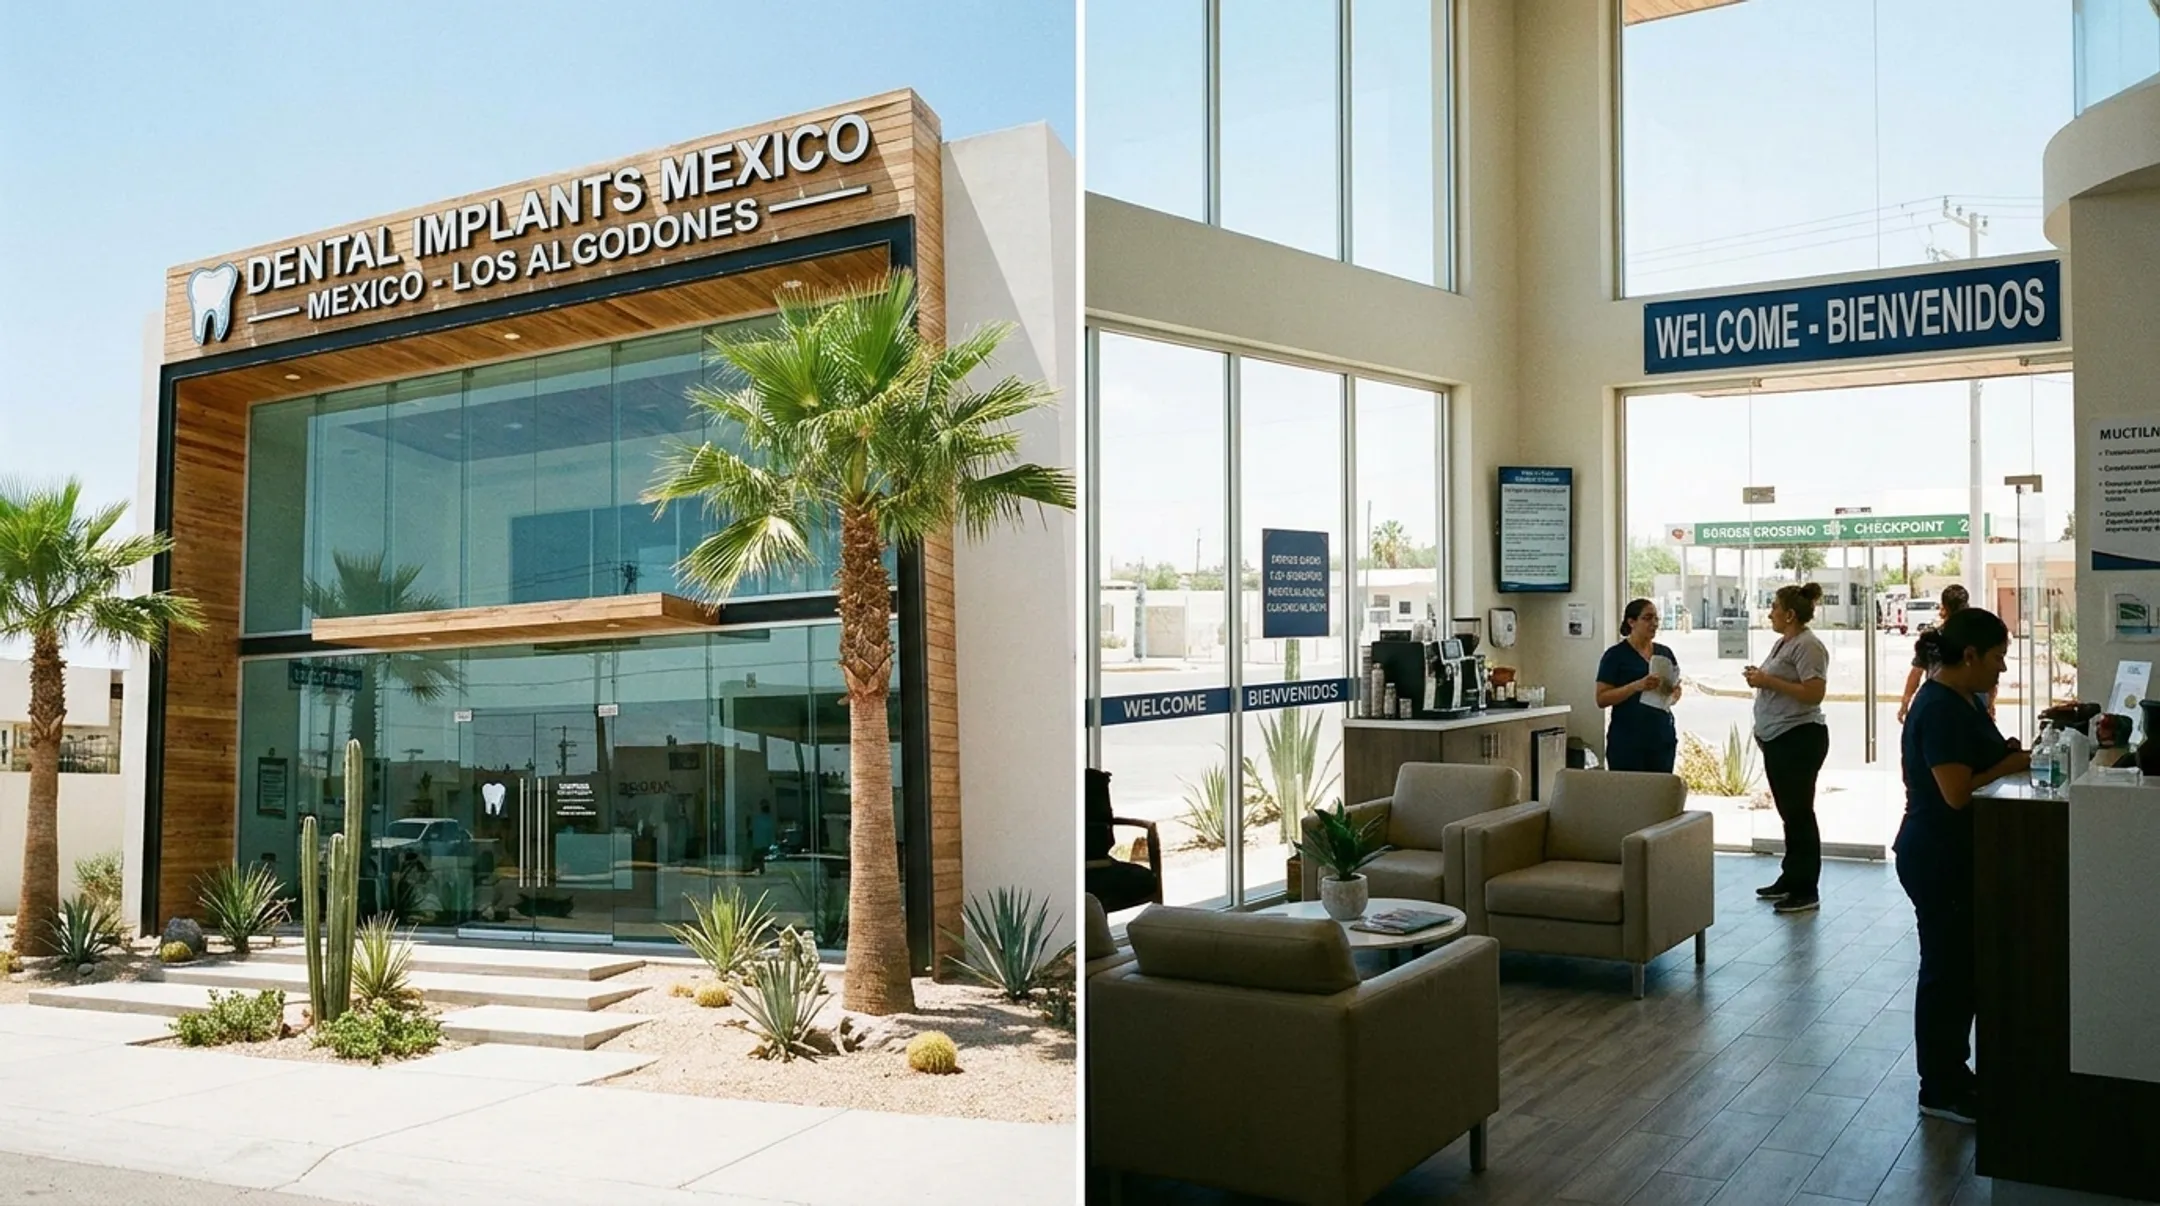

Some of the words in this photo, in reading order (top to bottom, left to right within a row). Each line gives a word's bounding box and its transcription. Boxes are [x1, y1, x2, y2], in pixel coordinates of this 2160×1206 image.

[247, 225, 400, 295] DENTAL
[412, 166, 643, 258] IMPLANTS
[659, 113, 871, 203] MEXICO
[307, 270, 424, 321] MEXICO
[453, 249, 518, 292] LOS
[525, 198, 759, 278] ALGODONES
[1655, 303, 1800, 360] WELCOME
[1827, 277, 2046, 345] BIENVENIDOS
[1853, 520, 1945, 535] CHECKPOINT
[1123, 694, 1207, 719] WELCOME
[1248, 683, 1339, 707] BIENVENIDOS
